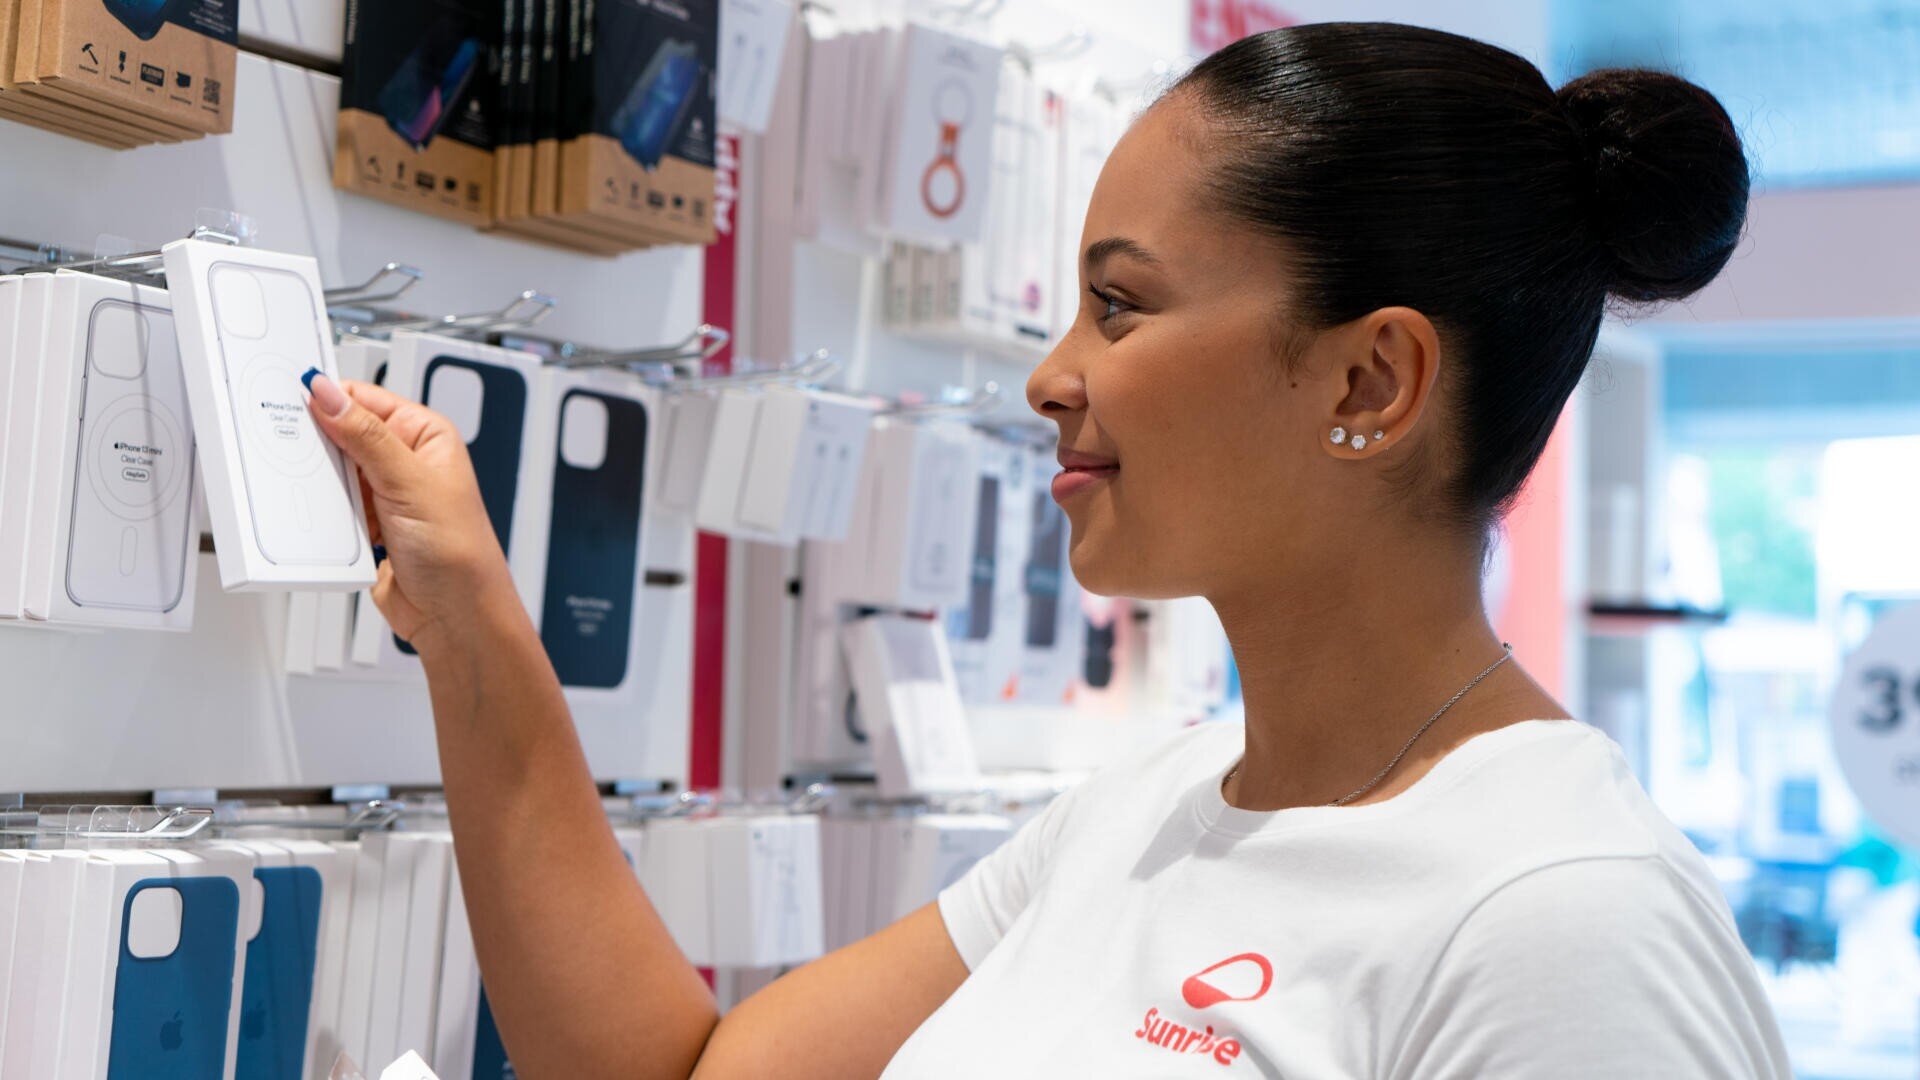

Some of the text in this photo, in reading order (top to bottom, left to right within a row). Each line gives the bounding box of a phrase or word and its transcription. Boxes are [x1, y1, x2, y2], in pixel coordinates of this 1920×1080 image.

[119, 442, 141, 452] iPhone
[120, 455, 153, 467] Clear Case
[1135, 1007, 1241, 1066] Sunrise
